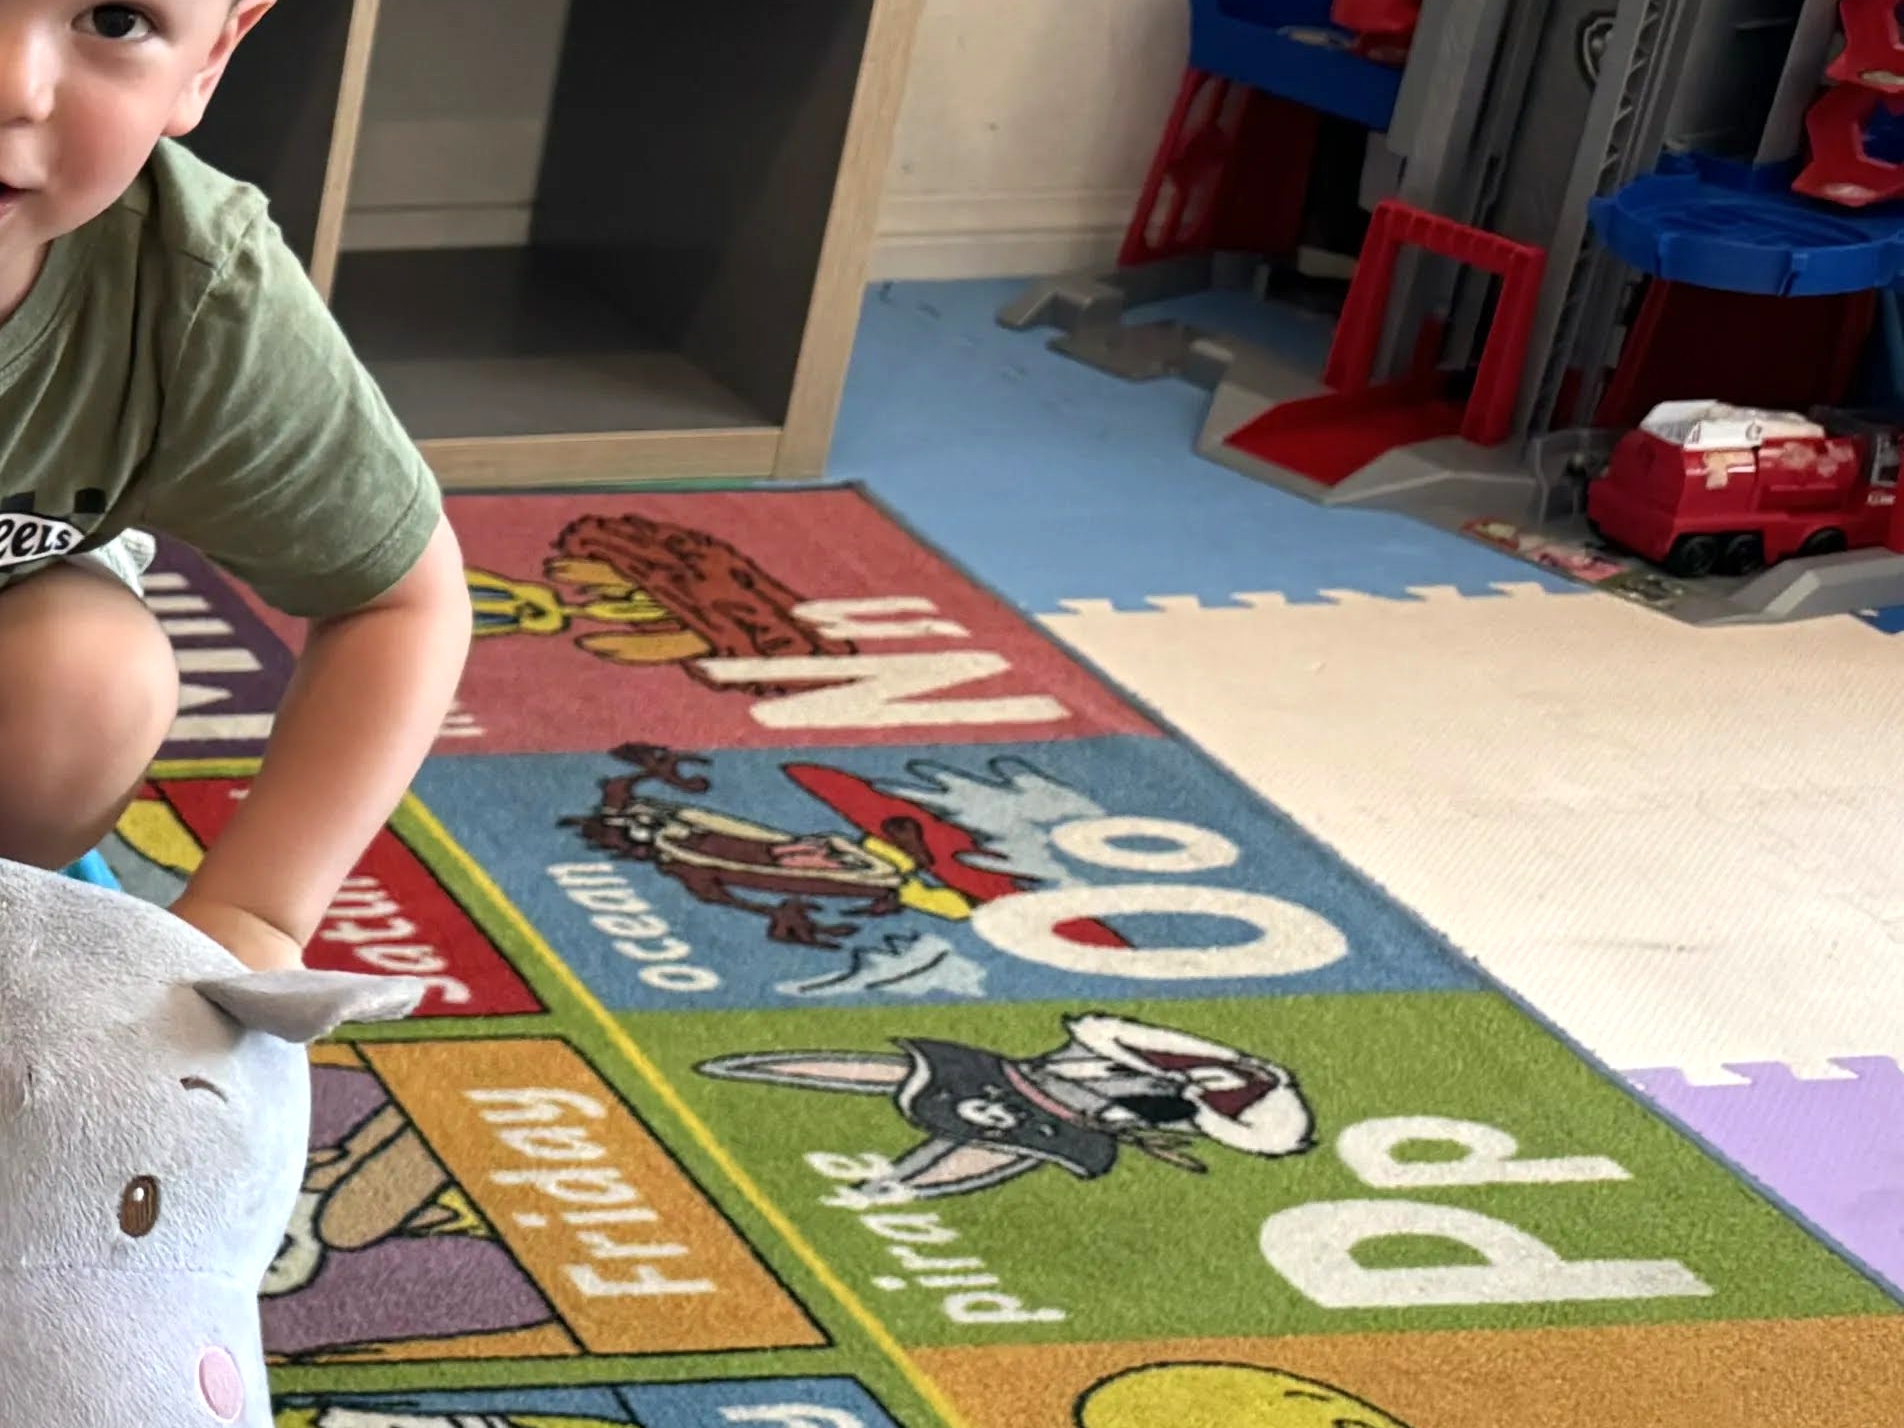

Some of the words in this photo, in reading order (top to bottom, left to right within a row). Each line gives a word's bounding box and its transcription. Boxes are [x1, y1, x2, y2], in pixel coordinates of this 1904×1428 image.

[698, 594, 1070, 730] Nn
[550, 862, 720, 993] ocean
[969, 815, 1350, 979] Oo
[465, 1086, 718, 1302] Friday
[804, 1150, 1068, 1329] pirate
[1259, 1115, 1715, 1309] Pp
